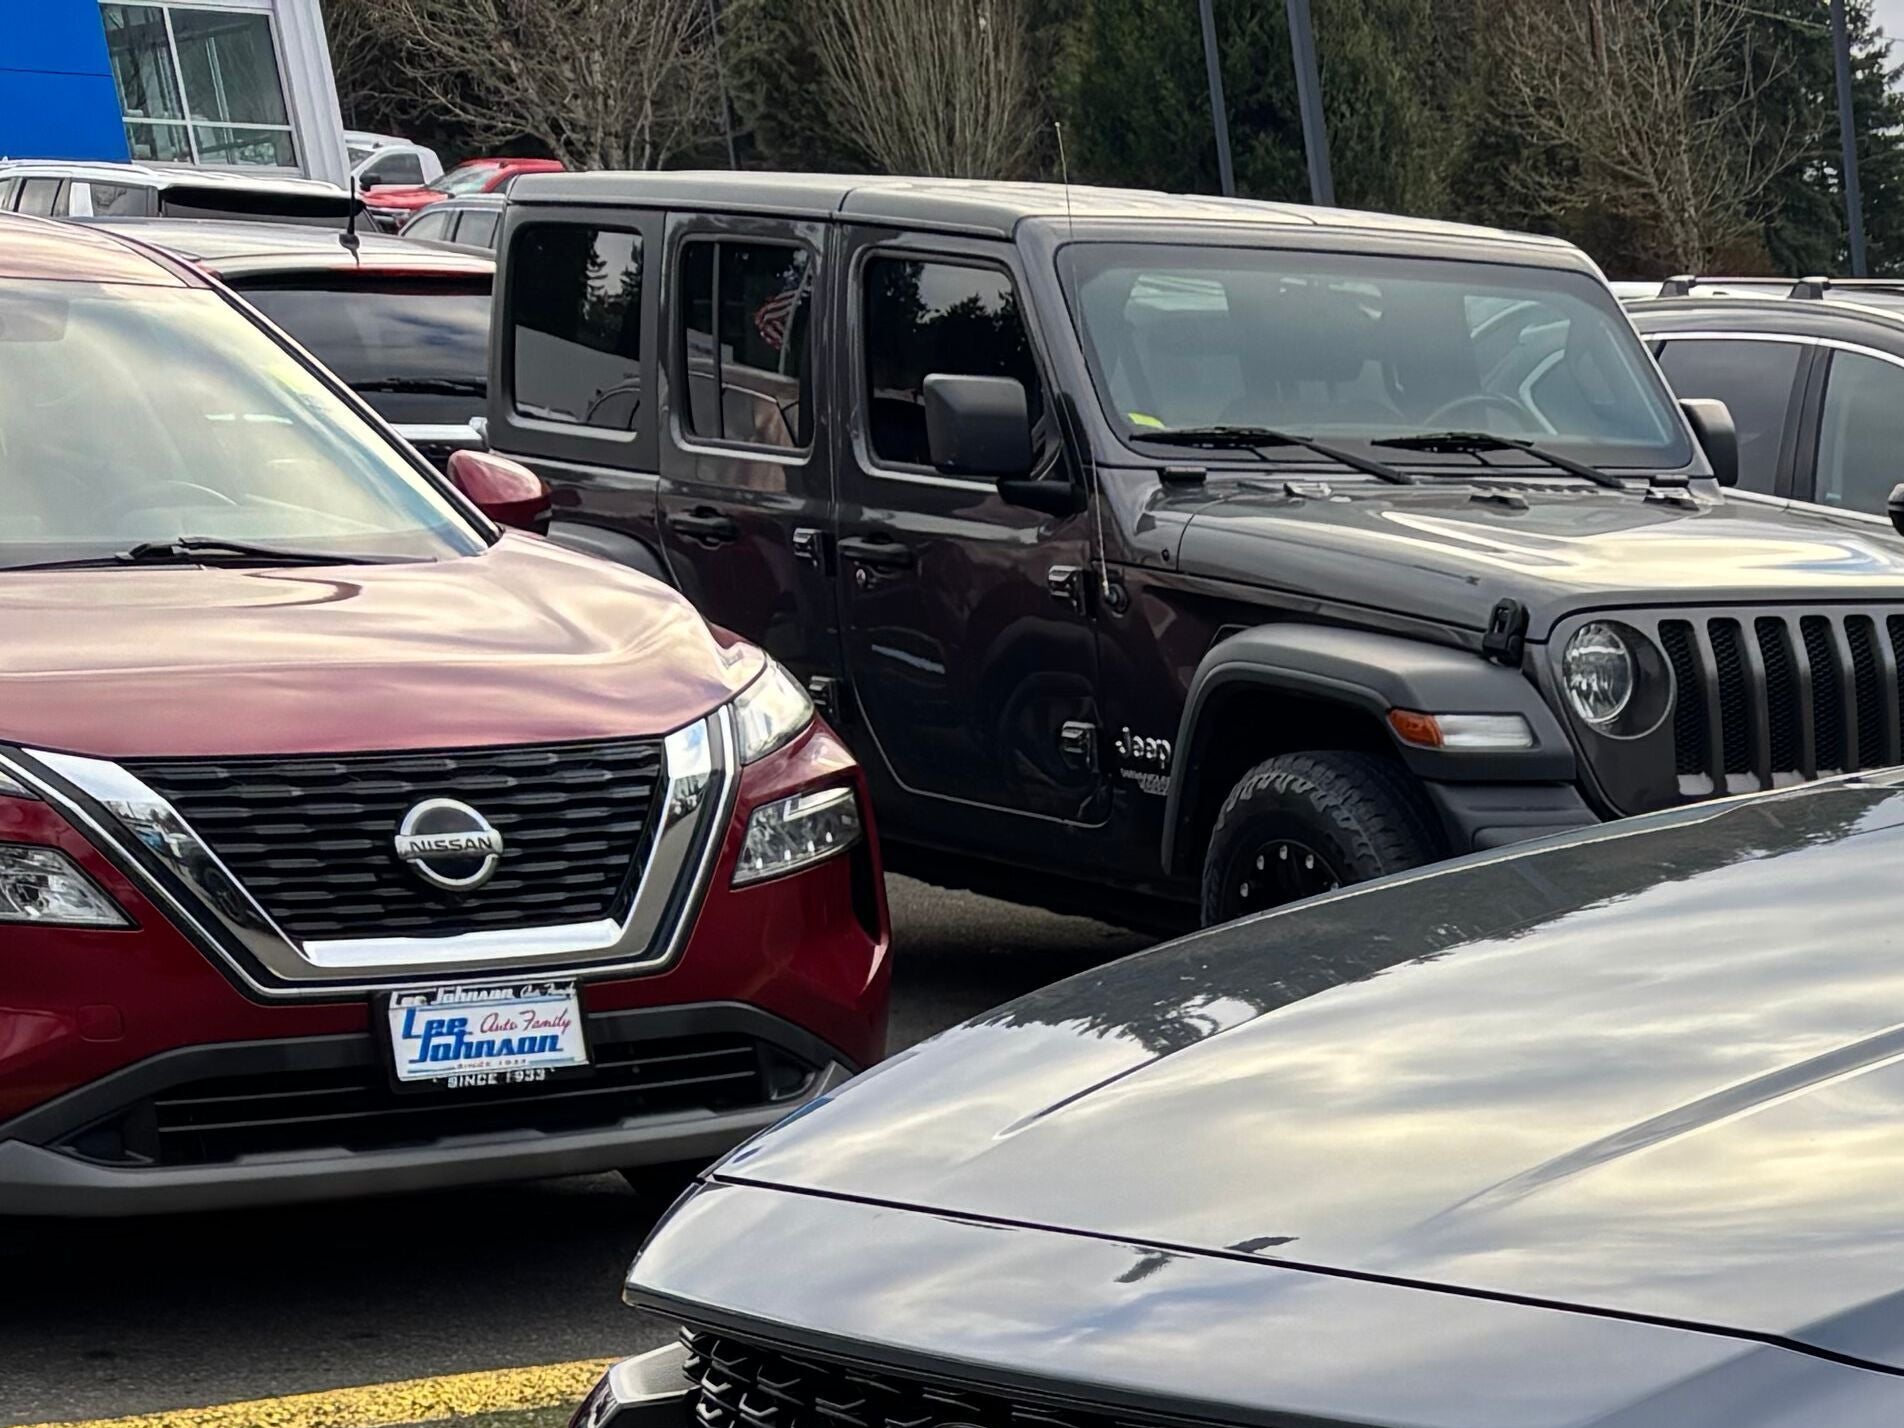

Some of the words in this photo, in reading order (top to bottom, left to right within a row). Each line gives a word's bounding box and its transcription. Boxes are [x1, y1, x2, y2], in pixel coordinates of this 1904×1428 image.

[1115, 726, 1172, 769] Jeep
[409, 836, 492, 853] NISSAN
[431, 985, 515, 1006] Johnson
[401, 1008, 473, 1040] Lee
[480, 1012, 518, 1034] Auto
[519, 1007, 572, 1038] Family
[408, 1030, 564, 1064] Johnson
[447, 1073, 498, 1089] SINCE
[505, 1068, 547, 1084] 1933
